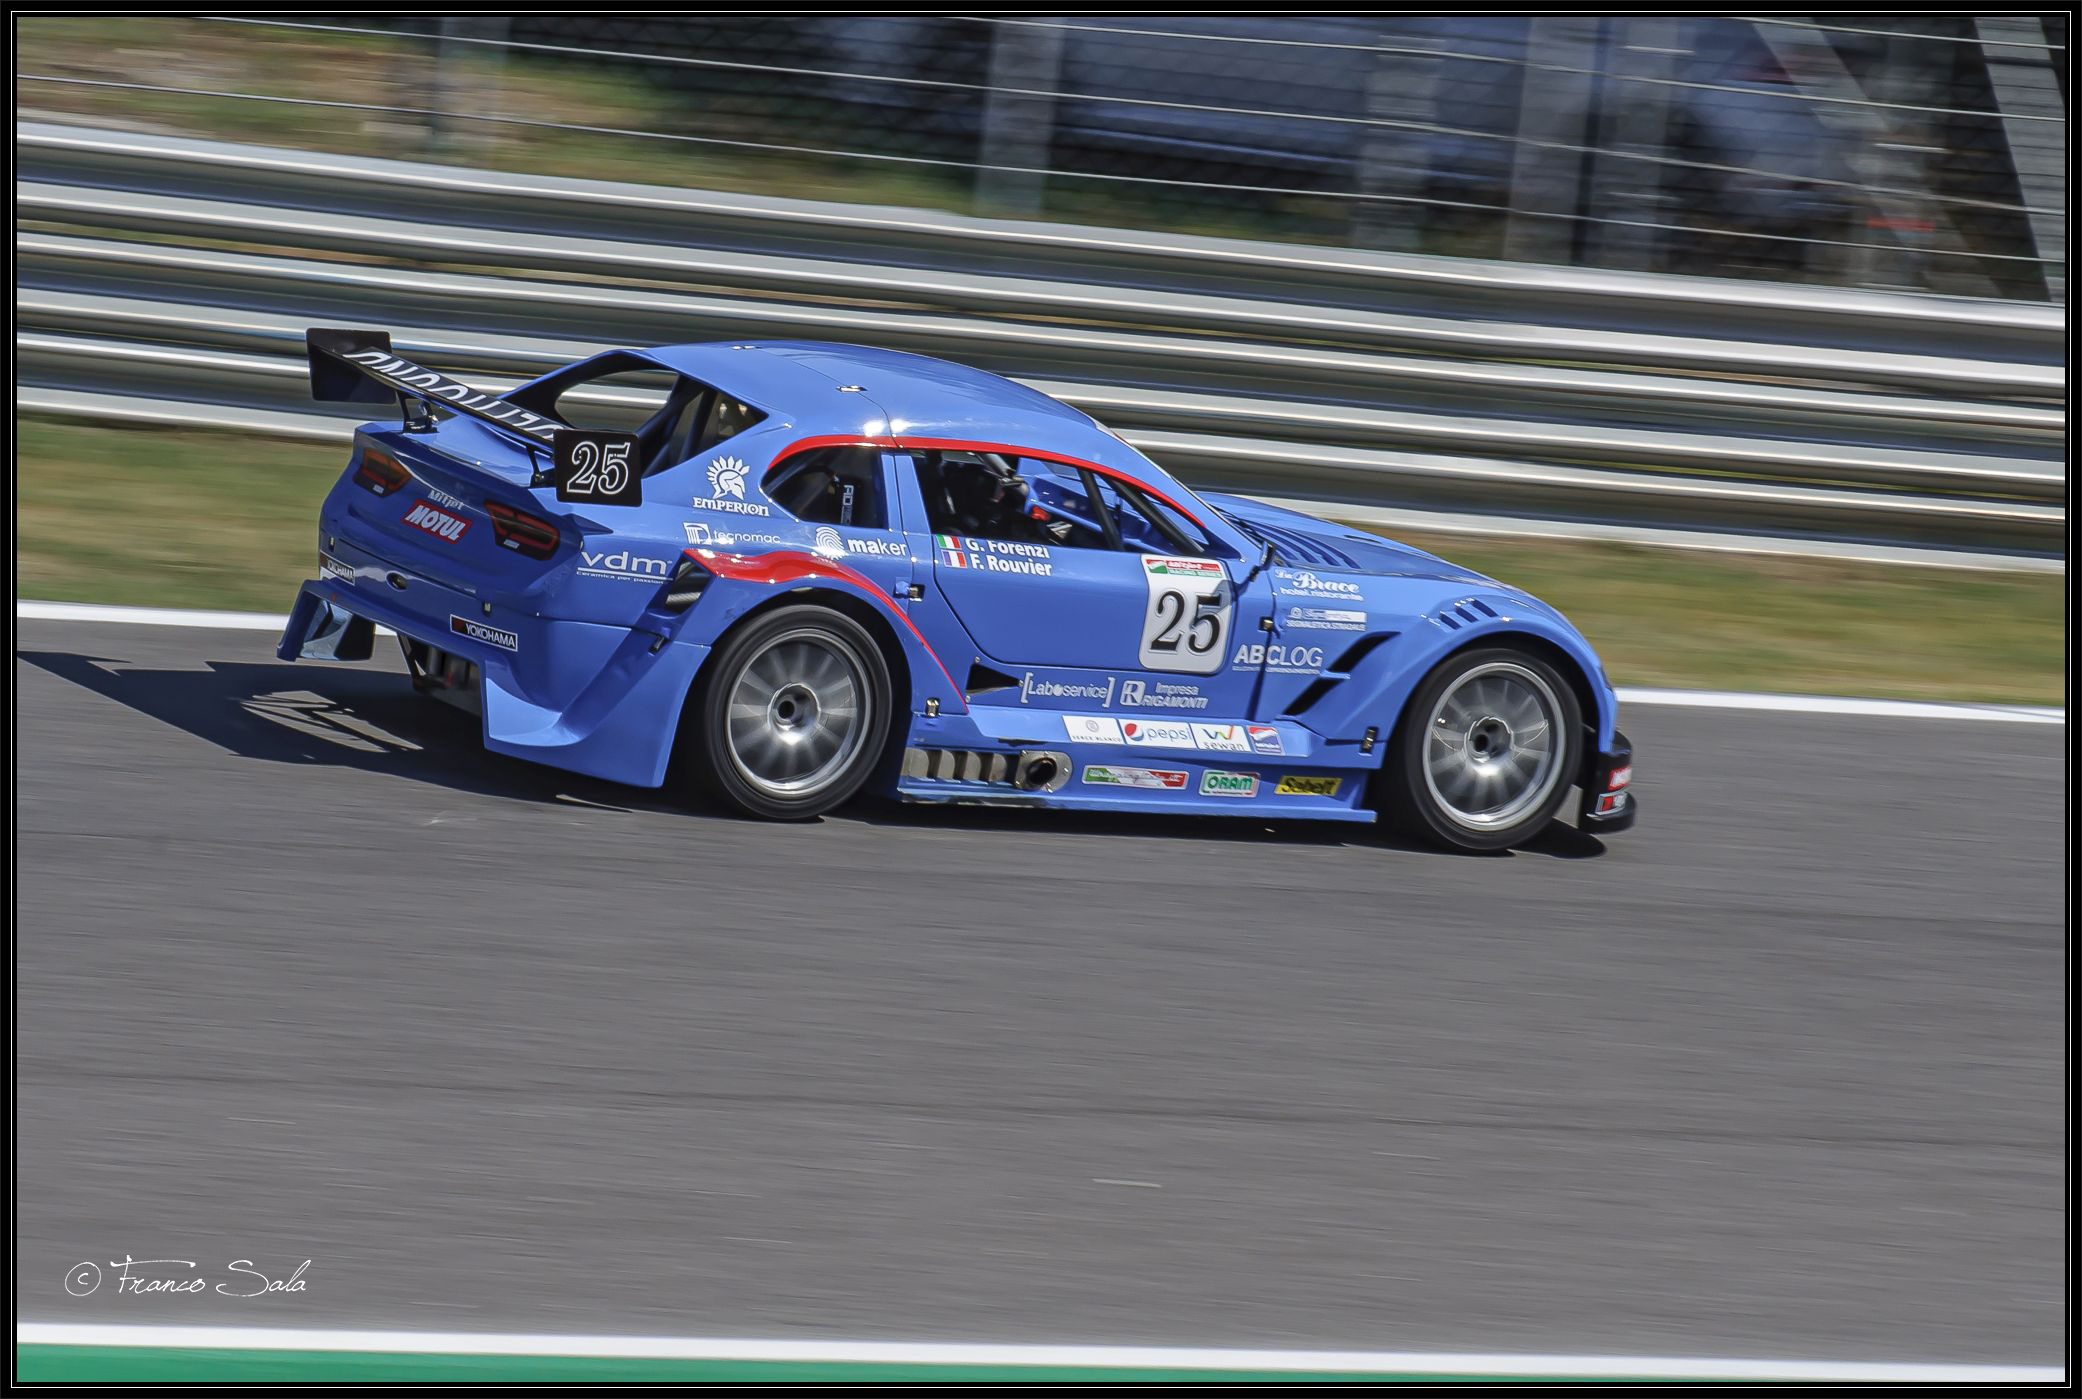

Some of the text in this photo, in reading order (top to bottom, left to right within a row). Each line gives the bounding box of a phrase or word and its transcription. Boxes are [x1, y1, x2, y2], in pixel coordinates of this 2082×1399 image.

[567, 441, 631, 495] 25
[404, 504, 466, 541] MOTUL
[713, 529, 782, 545] tecnomac
[847, 538, 908, 557] maker
[965, 537, 1051, 559] G. Forenzi
[581, 551, 668, 575] vdm
[969, 553, 1054, 577] F. Rouvier
[1291, 571, 1361, 594] Brace
[1149, 589, 1221, 655] 25
[464, 622, 517, 648] YOKOHAMA
[1232, 643, 1324, 668] ABCLOG
[1155, 681, 1200, 697] Impresa
[1146, 727, 1192, 743] pepsi
[1203, 740, 1246, 752] sewan
[1207, 775, 1254, 792] ORAM
